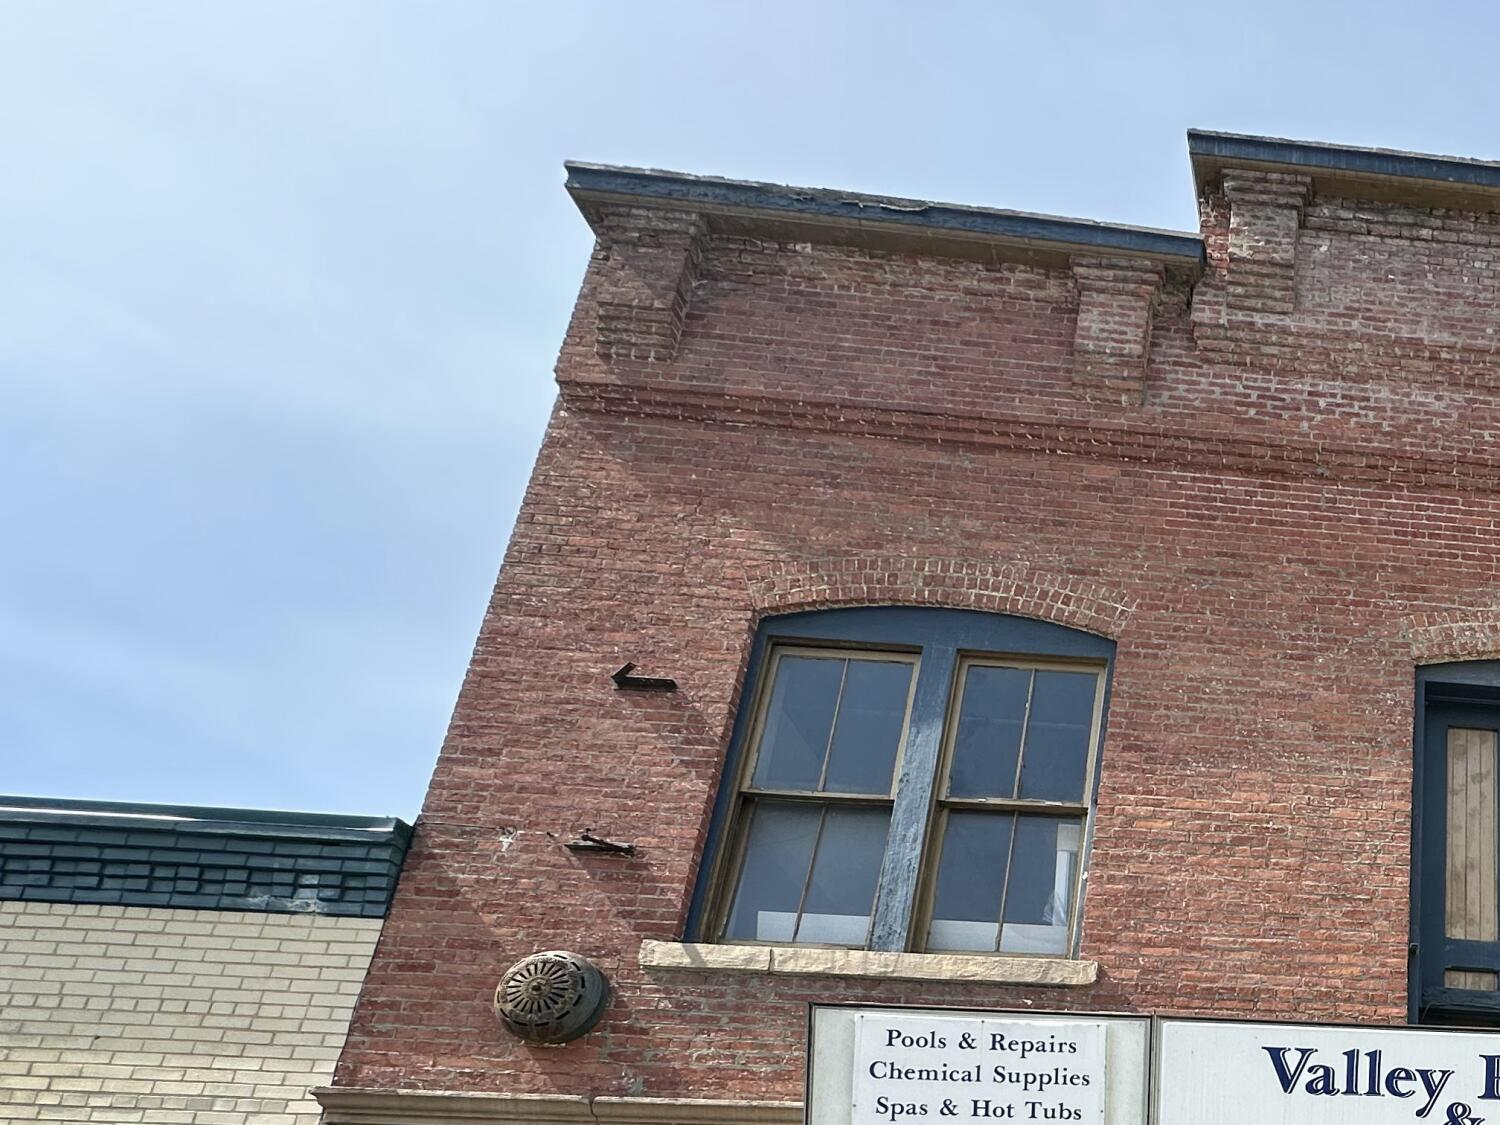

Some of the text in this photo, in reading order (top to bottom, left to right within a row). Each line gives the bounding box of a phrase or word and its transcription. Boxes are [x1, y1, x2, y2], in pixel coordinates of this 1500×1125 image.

[886, 1029, 1076, 1058] Pools & Repairs
[869, 1061, 1090, 1091] Chemical Supplies
[1261, 1047, 1455, 1118] Valley
[876, 1096, 1081, 1121] Spas & Hot Tubs
